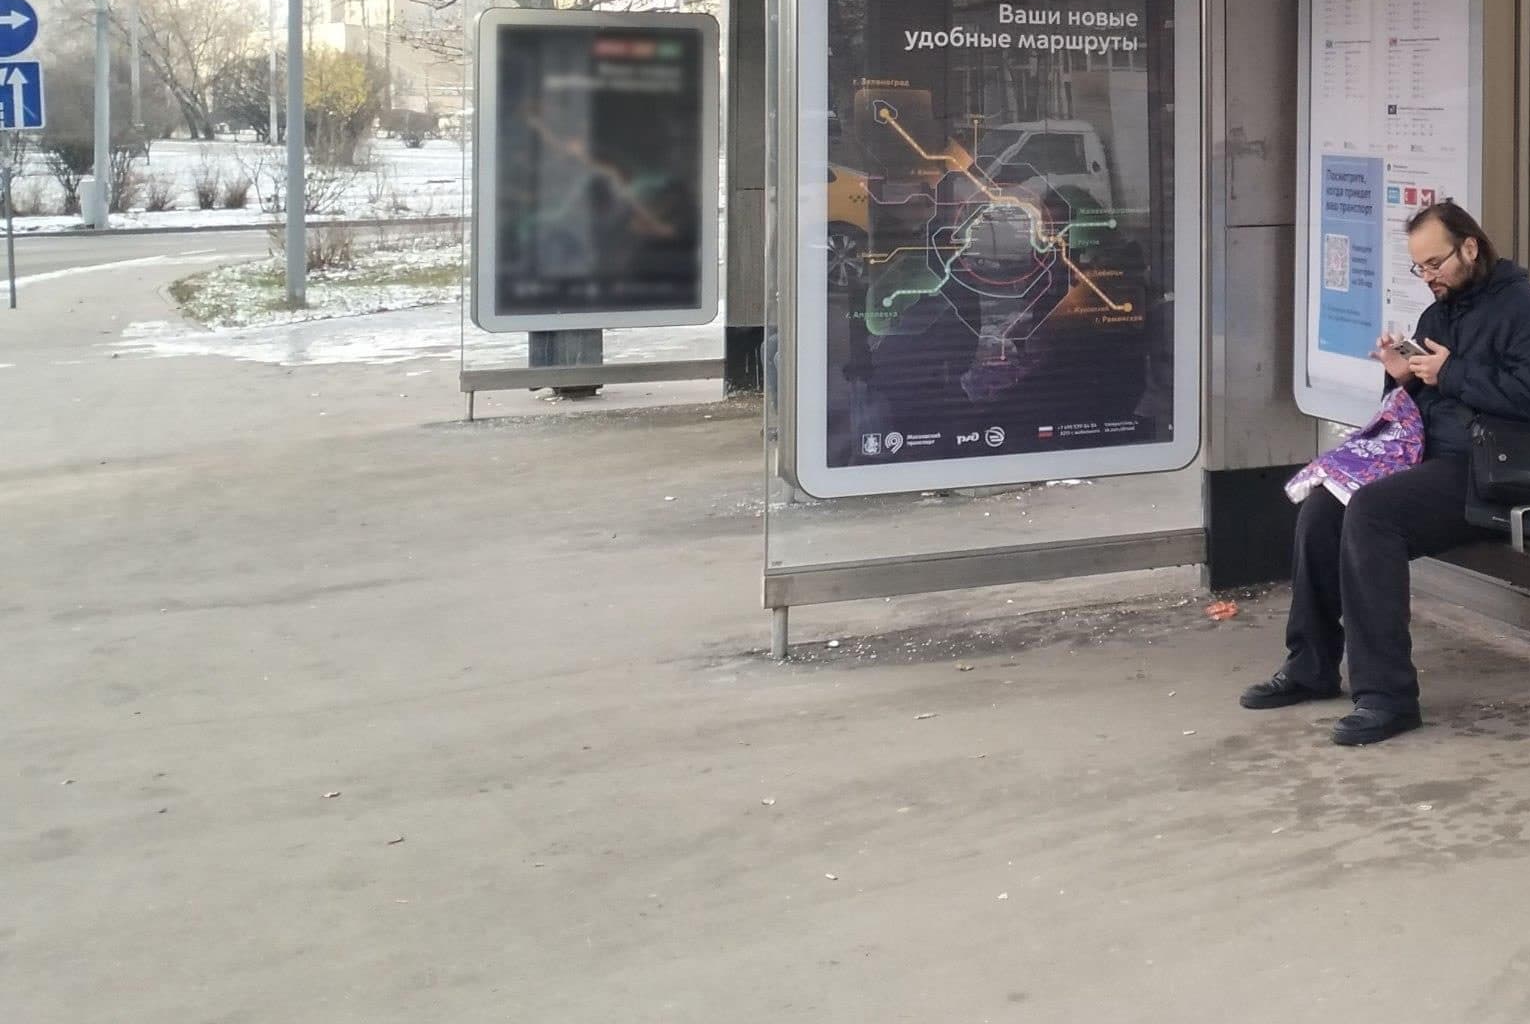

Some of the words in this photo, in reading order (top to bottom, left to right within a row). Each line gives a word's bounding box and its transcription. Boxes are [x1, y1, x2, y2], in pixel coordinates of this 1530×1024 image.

[998, 3, 1062, 26] Ваши
[1068, 10, 1139, 28] новые
[904, 26, 1012, 52] удобные
[1018, 33, 1138, 55] маршруты
